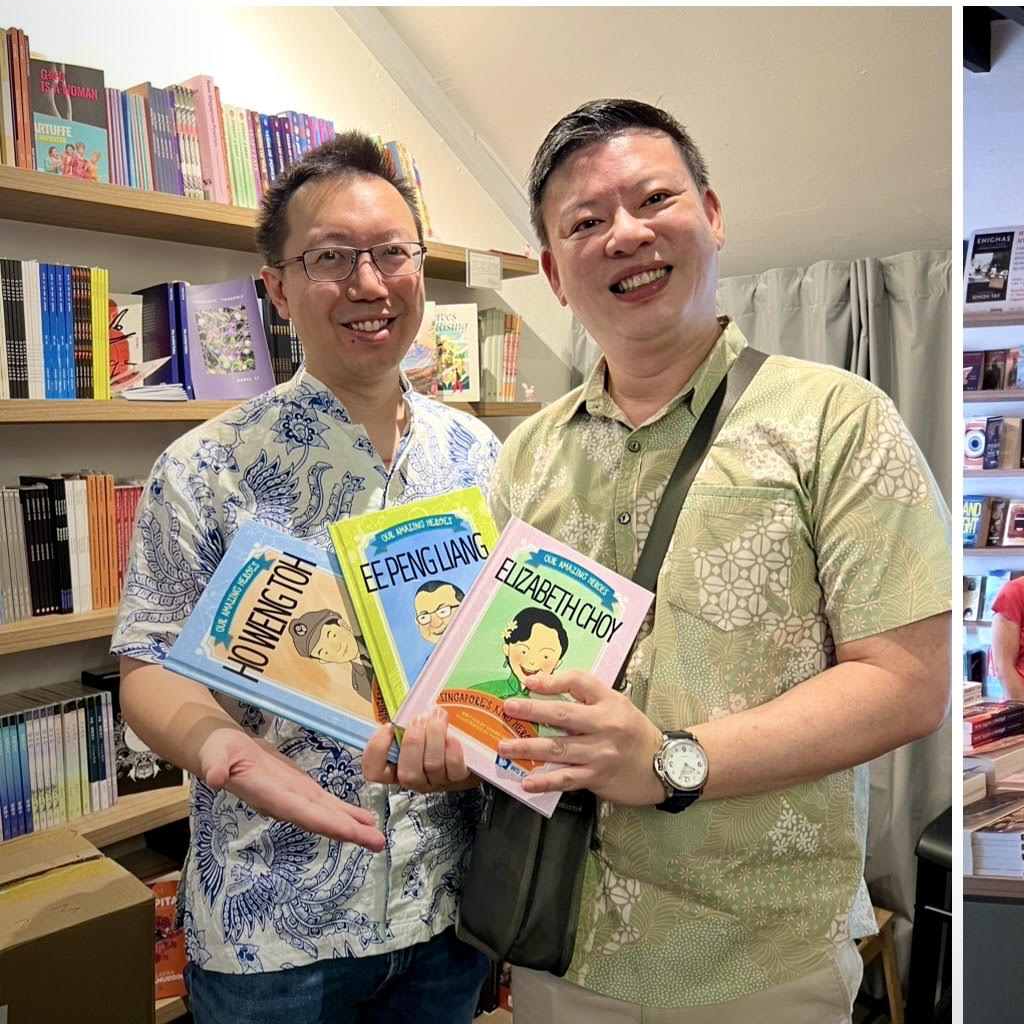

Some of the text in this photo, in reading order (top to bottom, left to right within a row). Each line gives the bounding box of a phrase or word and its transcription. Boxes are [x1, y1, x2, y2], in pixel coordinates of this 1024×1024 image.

[34, 122, 72, 138] ARTUFFE
[977, 235, 1011, 245] ENIGMAS
[381, 516, 453, 542] OUR AMAZING HEROES
[360, 533, 489, 593] EE PENG LIANG
[543, 553, 610, 597] OUR AMAZING HEROES
[216, 562, 261, 633] OUR AMAZING HEROES
[222, 551, 317, 684] HO WENG TOH
[494, 557, 624, 644] ELIZABETH CHOY
[440, 692, 493, 710] SINGAPORE'S
